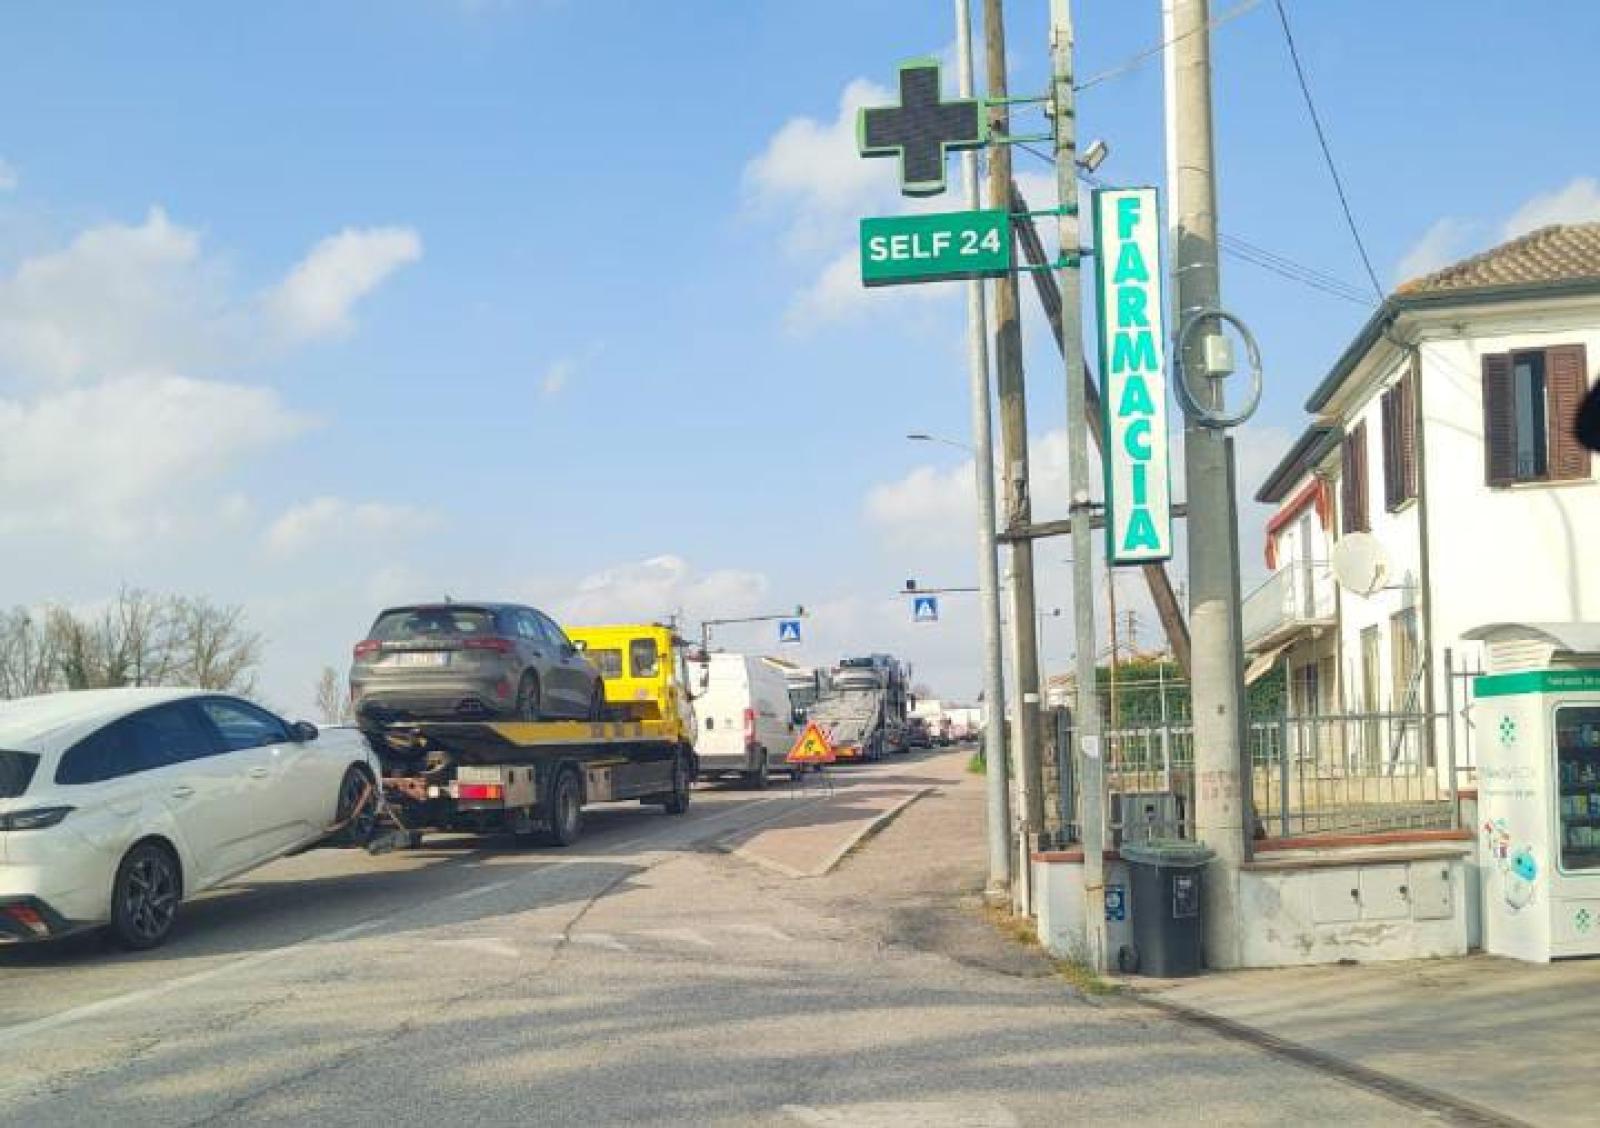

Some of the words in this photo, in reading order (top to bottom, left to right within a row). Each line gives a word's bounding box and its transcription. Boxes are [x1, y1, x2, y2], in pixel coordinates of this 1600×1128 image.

[868, 232, 952, 262] SELF
[959, 228, 1001, 255] 24
[1112, 197, 1161, 552] FARMACIA
